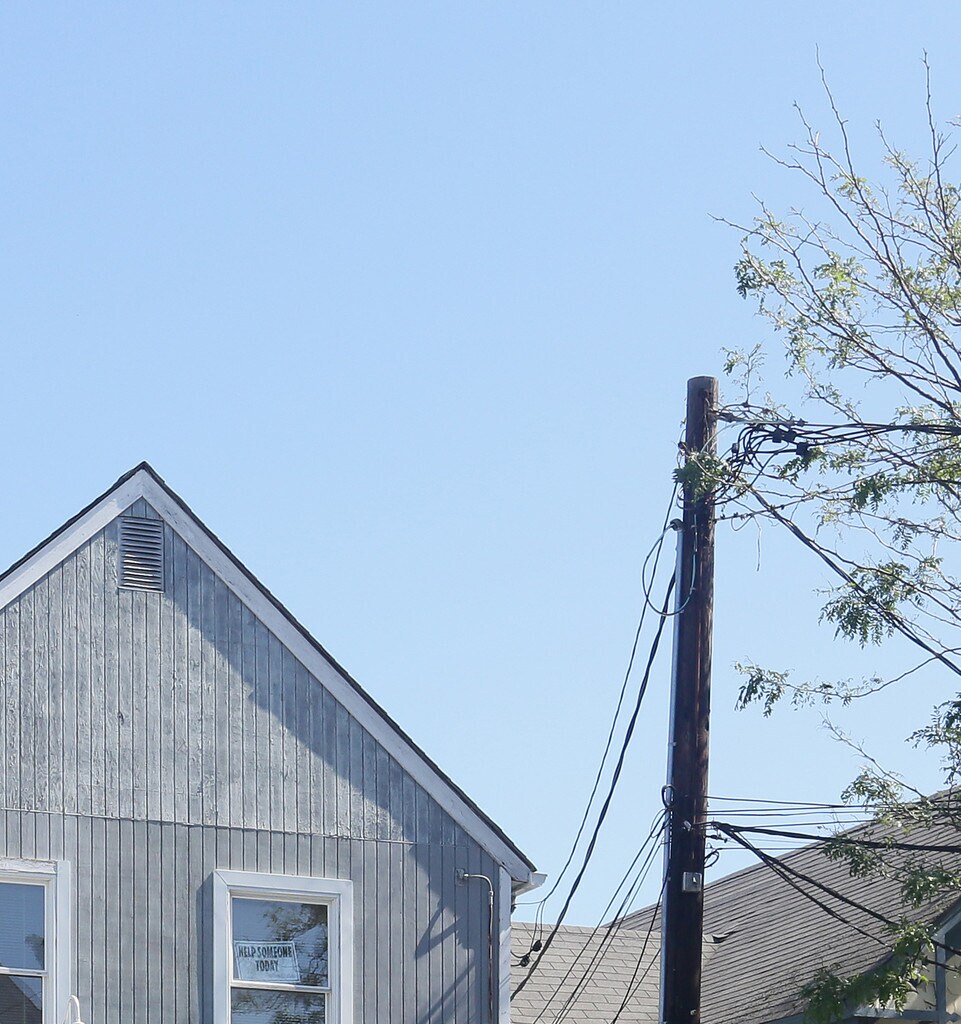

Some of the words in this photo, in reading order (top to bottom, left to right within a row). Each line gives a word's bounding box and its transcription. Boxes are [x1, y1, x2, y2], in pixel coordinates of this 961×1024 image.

[239, 946, 256, 958] HELP
[257, 946, 292, 959] SOMEONE
[255, 959, 279, 972] TODAY
